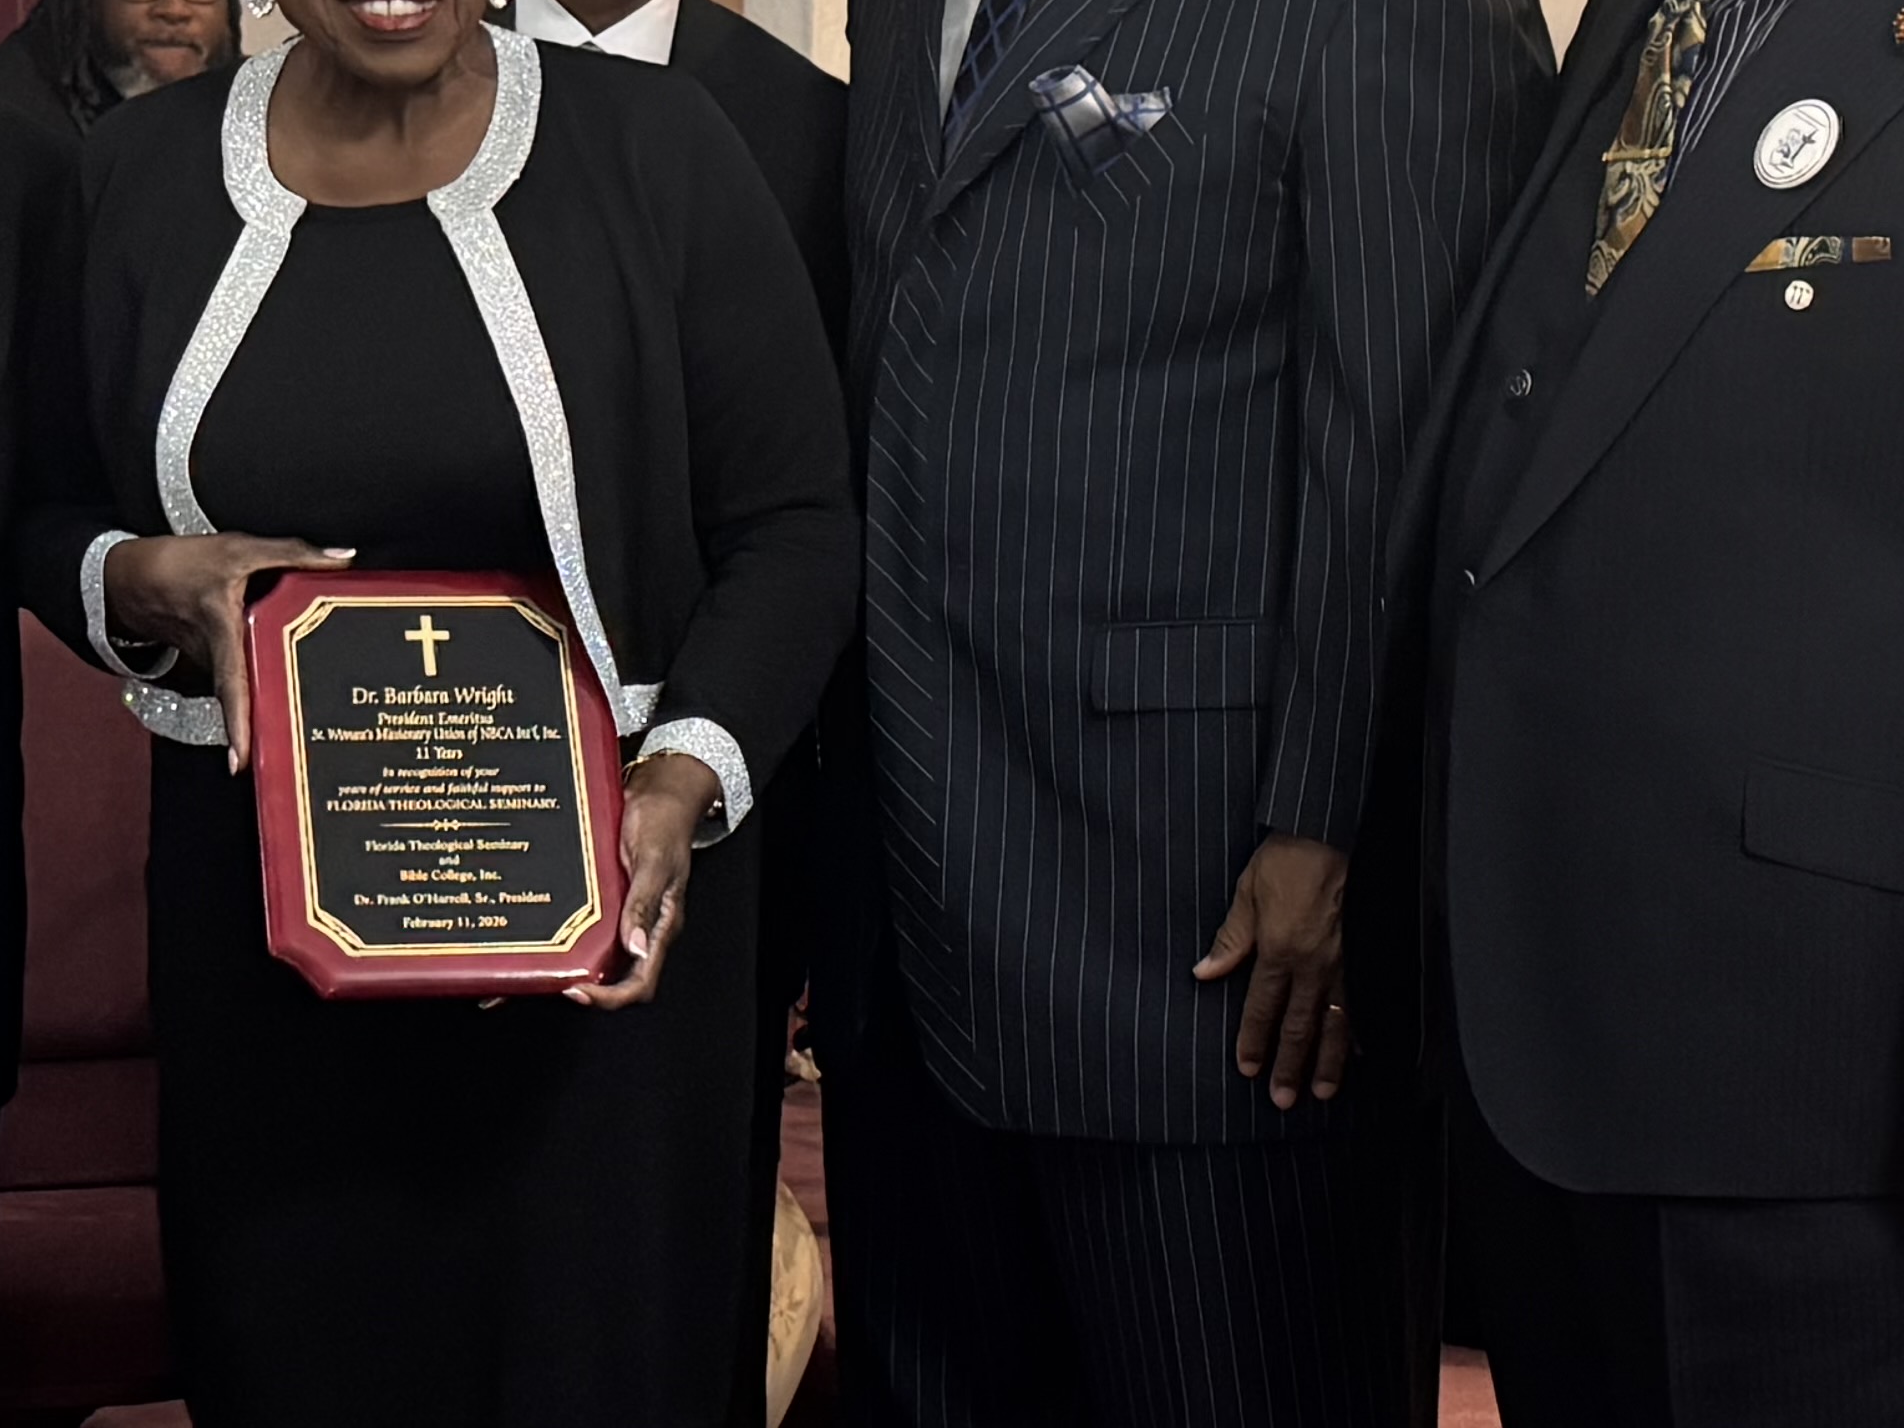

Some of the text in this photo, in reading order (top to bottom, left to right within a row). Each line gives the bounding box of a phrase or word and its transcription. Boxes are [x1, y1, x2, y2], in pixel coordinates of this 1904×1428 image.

[352, 684, 515, 711] Dr. Barbara Wright
[378, 710, 494, 725] President Emeritus
[434, 726, 466, 740] Union
[467, 724, 478, 745] of
[416, 745, 464, 760] 11 Years
[460, 766, 474, 779] of
[338, 786, 367, 797] years
[368, 782, 382, 796] of
[383, 783, 421, 794] service
[422, 782, 446, 794] and
[490, 784, 532, 796] support
[534, 783, 546, 793] to
[326, 798, 560, 812] FLORIDA THEOLOGICAL SEMINARY.
[365, 838, 530, 853] Florida Theological Seminary
[438, 854, 460, 866] and
[400, 869, 429, 882] Bible
[480, 868, 502, 881] Inc.
[354, 894, 374, 906] Dr.
[377, 893, 411, 906] Frank
[498, 890, 552, 904] President
[402, 916, 454, 930] February
